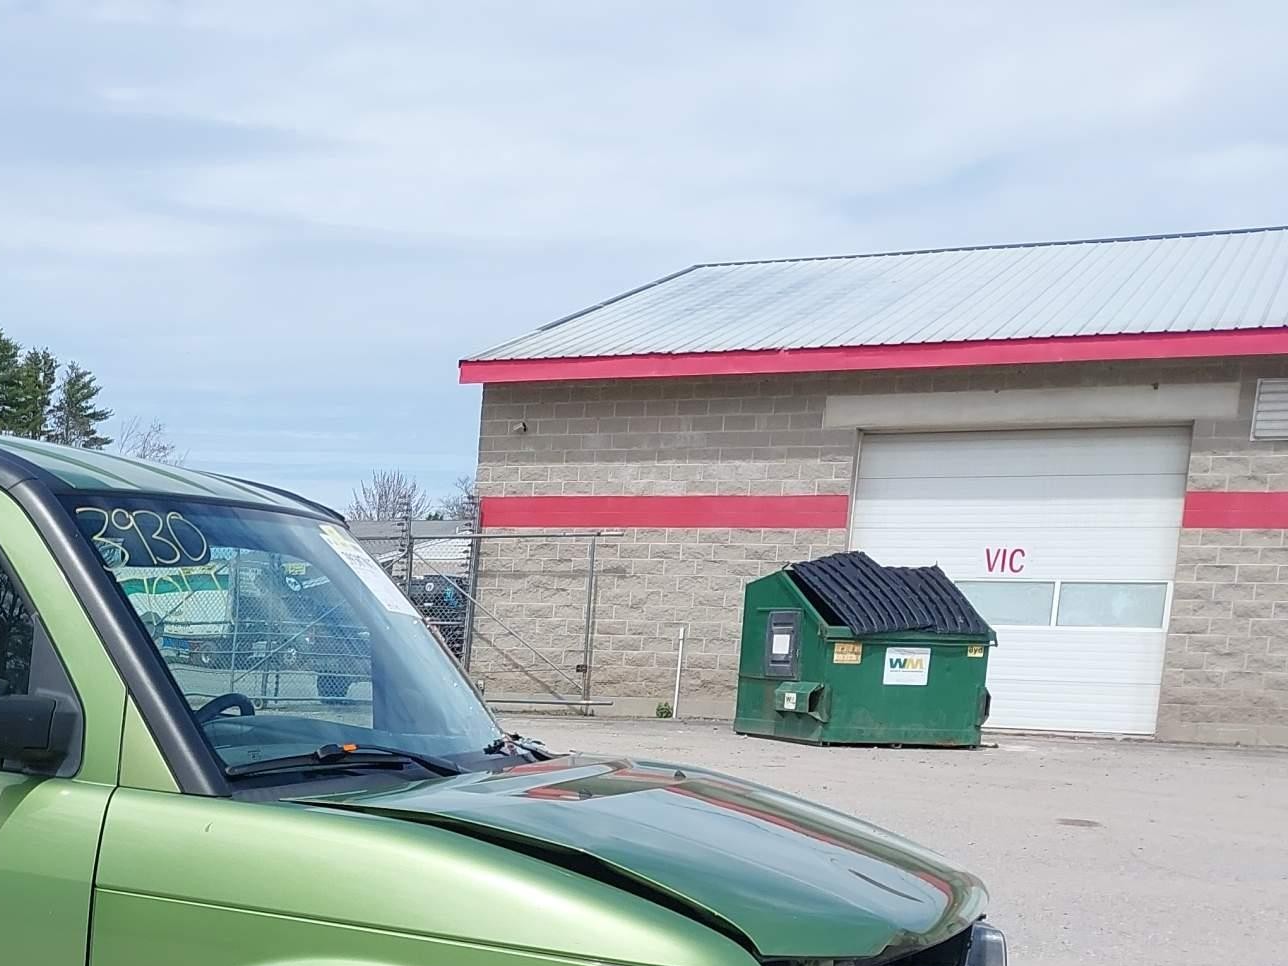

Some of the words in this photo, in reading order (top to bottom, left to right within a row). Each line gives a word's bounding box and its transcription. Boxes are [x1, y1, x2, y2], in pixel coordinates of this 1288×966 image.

[75, 506, 208, 572] 3930
[985, 548, 1026, 574] VIC
[889, 657, 925, 669] WM
